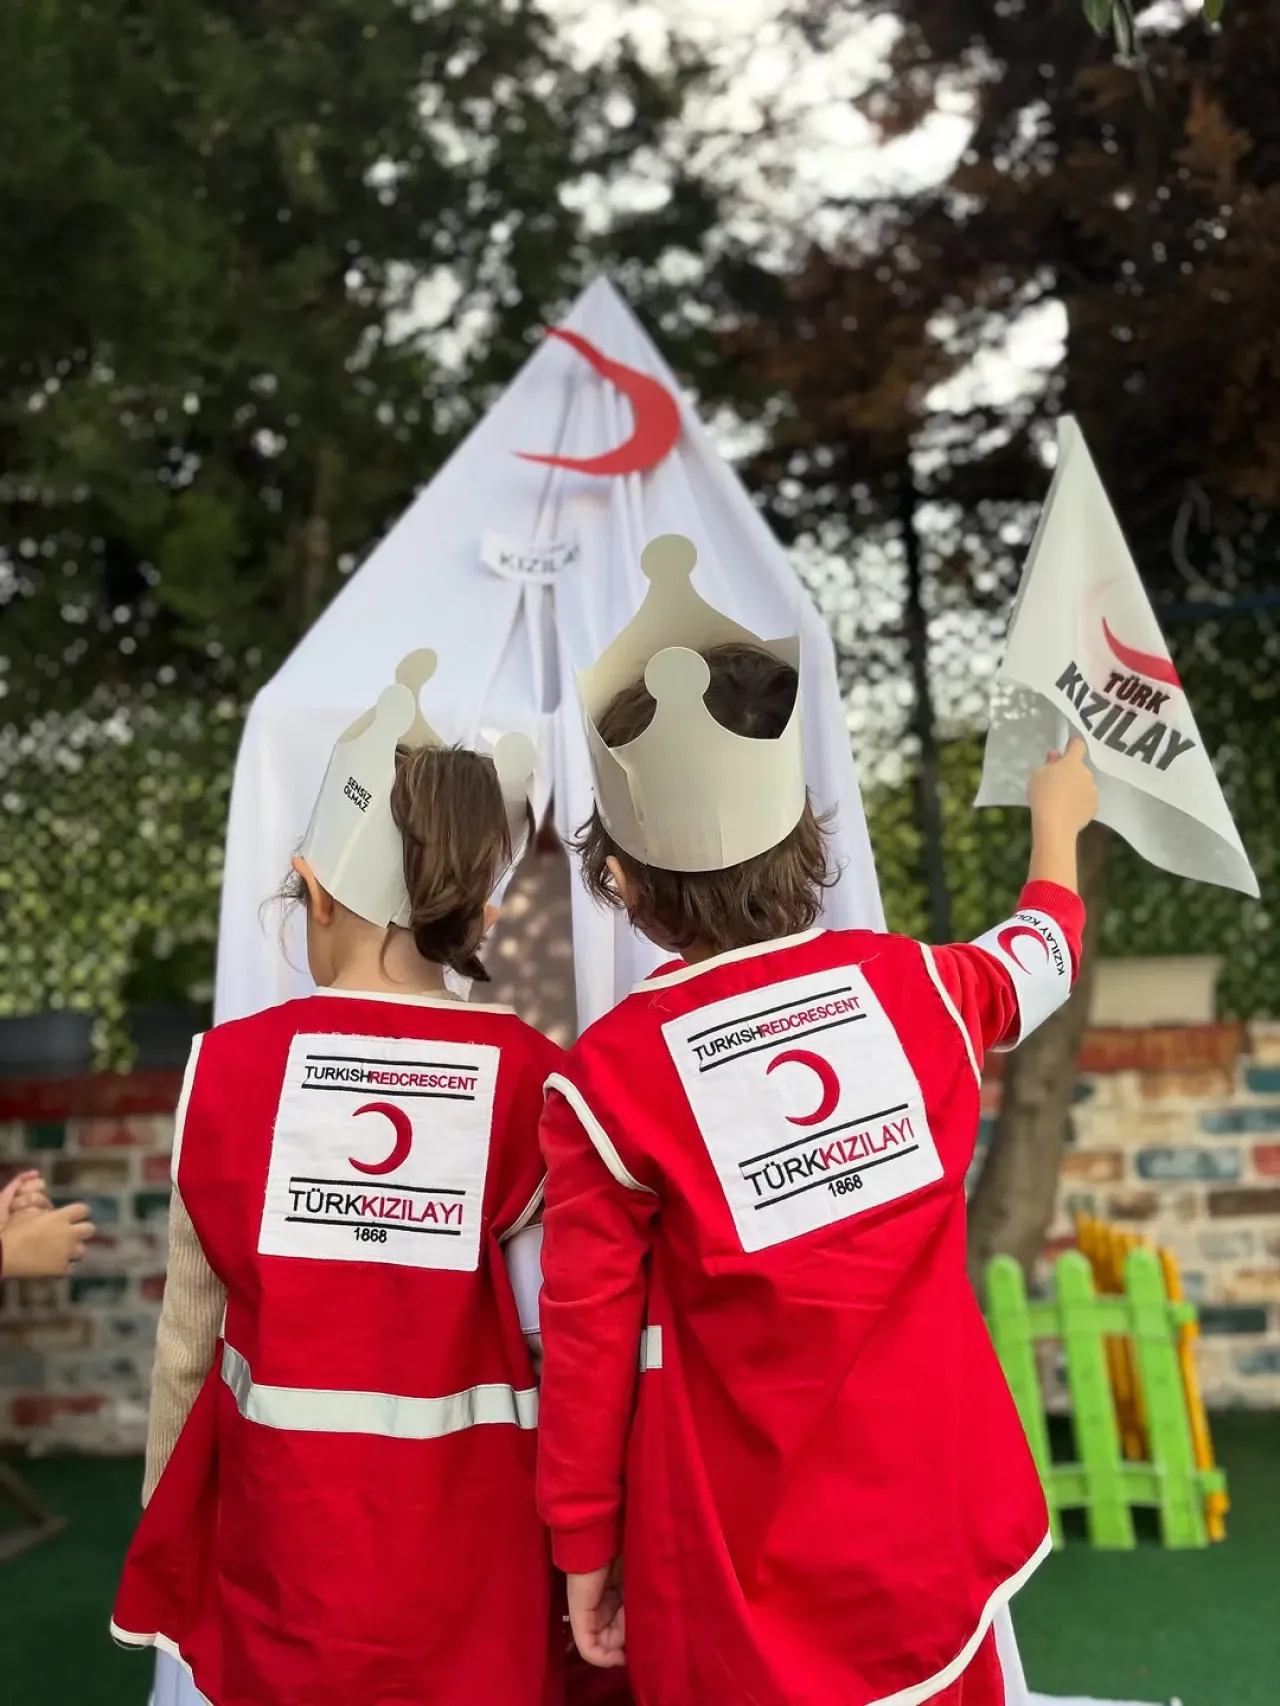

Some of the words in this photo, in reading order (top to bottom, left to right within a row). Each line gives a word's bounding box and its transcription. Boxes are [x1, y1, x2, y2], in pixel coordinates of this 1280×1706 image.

[1103, 671, 1171, 715] TÜRK
[1055, 661, 1196, 771] KIZILAY
[1039, 927, 1065, 976] KIZILAY
[828, 1174, 864, 1198] 1868
[353, 1226, 387, 1243] 1868
